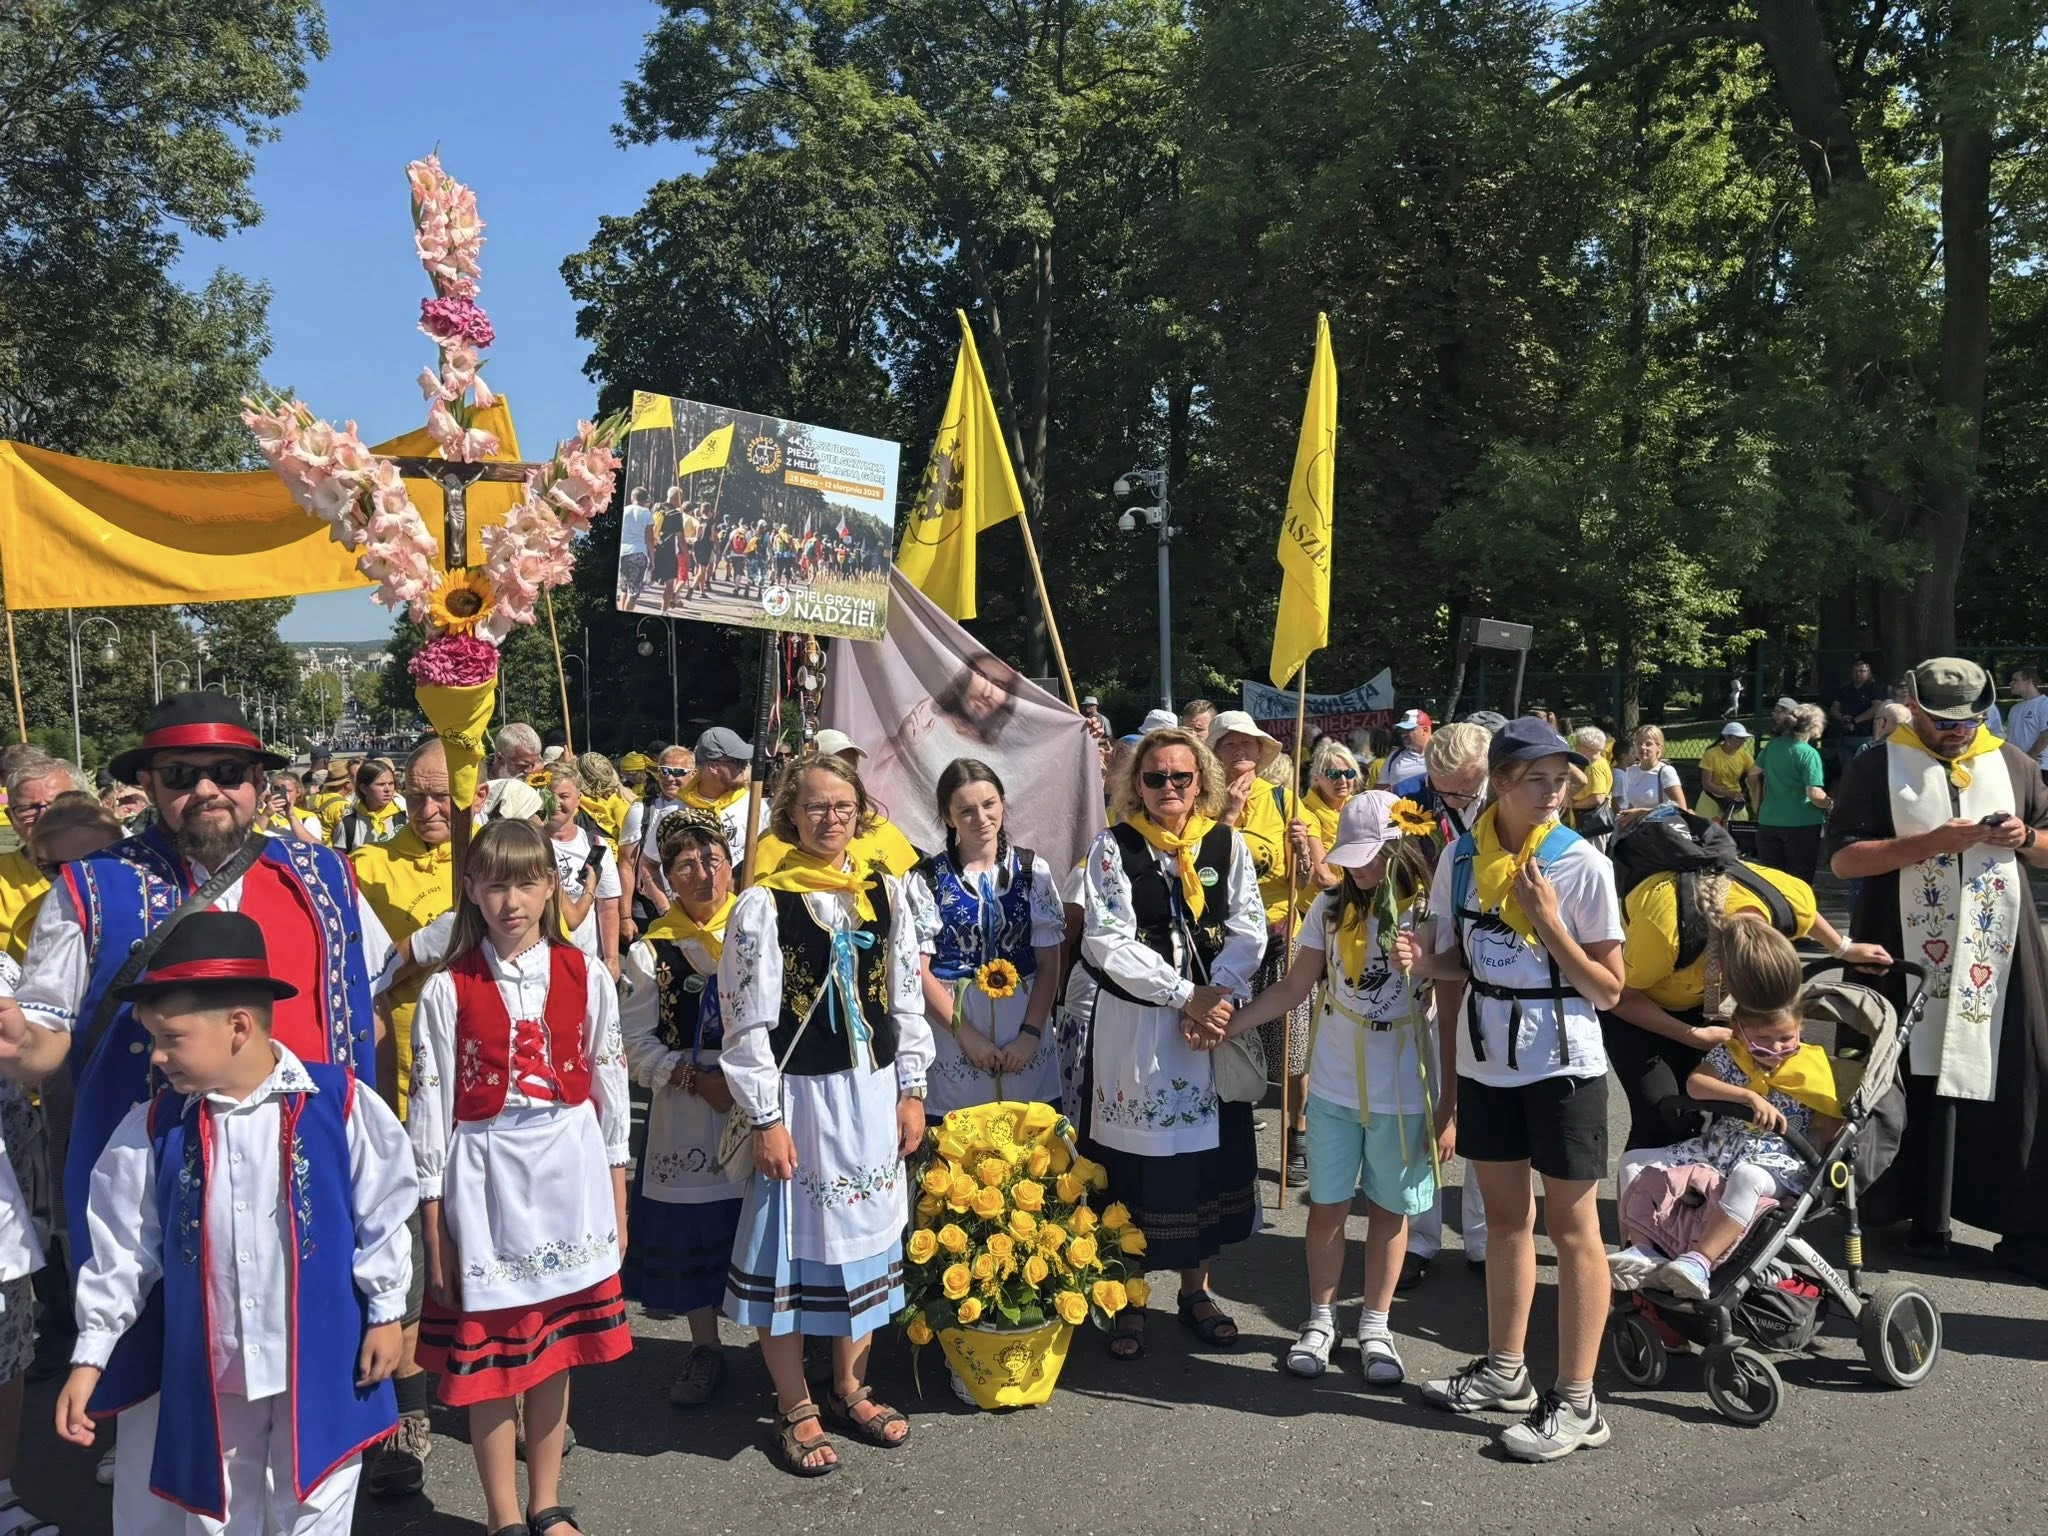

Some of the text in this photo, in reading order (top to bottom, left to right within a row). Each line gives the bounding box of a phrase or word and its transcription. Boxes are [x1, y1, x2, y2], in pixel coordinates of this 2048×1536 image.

[786, 458, 792, 466] Z
[793, 459, 816, 470] HELU
[787, 447, 886, 474] PIESZA PIELGRZYMKA
[800, 475, 819, 487] lipca
[832, 482, 863, 494] sierpnia
[795, 590, 876, 611] PIELGRZYMI
[794, 602, 875, 628] NADZIEI
[1268, 710, 1391, 735] ARCDIECEZJA
[1811, 1253, 1849, 1296] DYNAMIC
